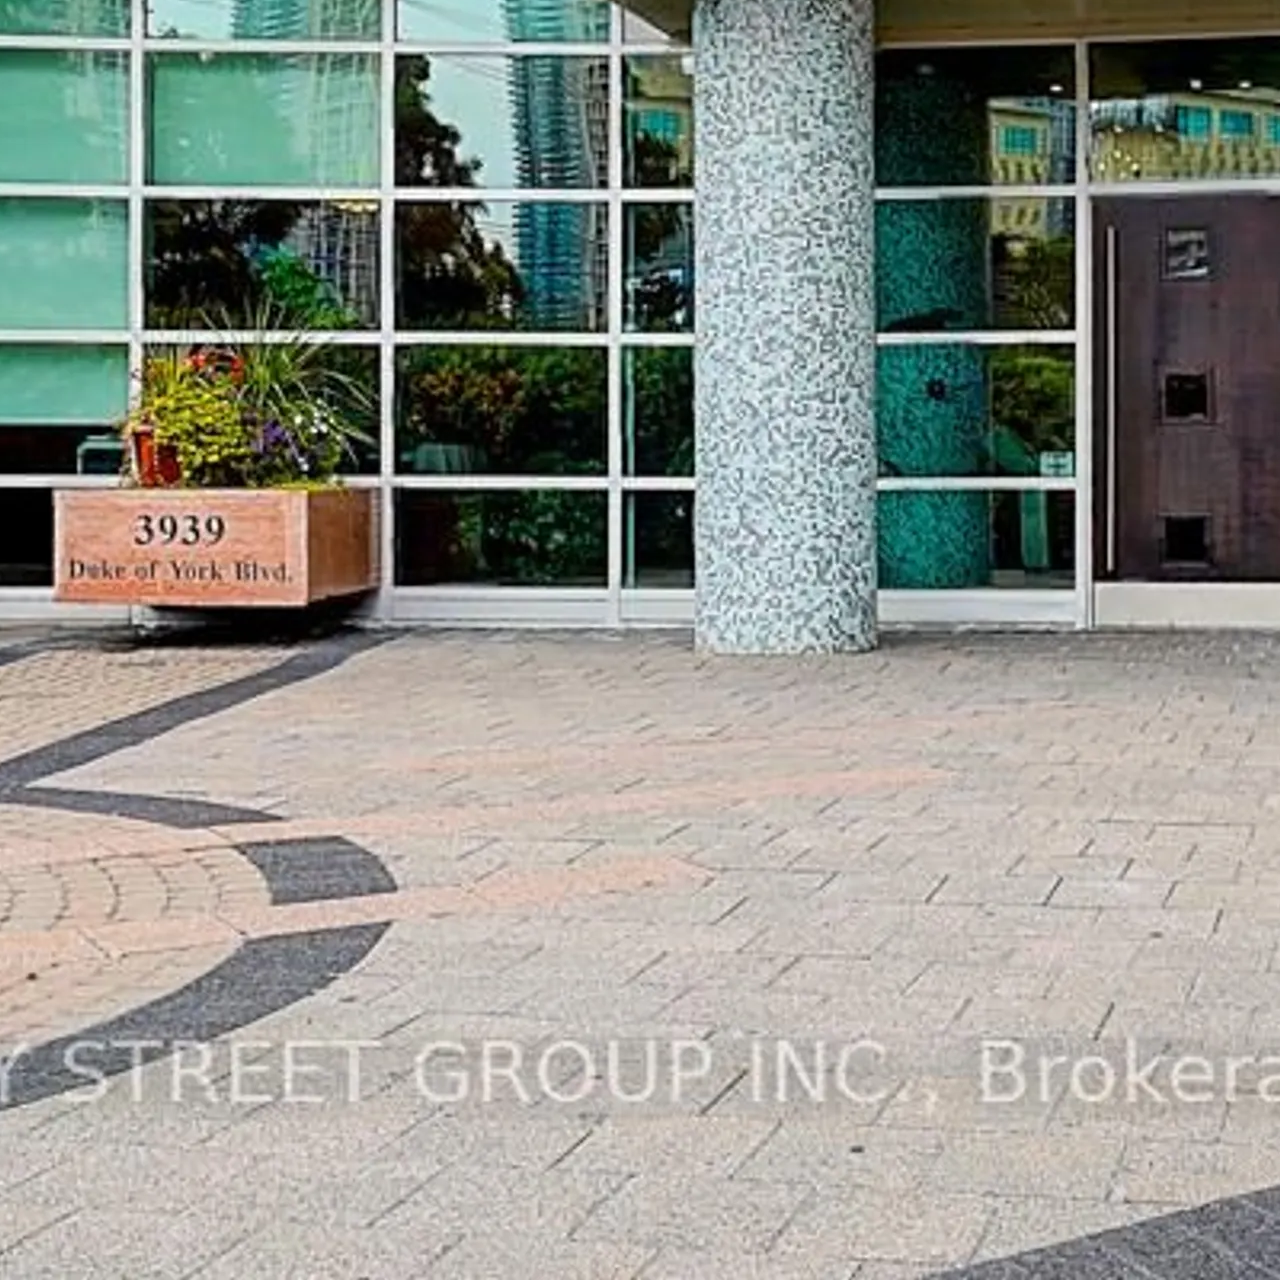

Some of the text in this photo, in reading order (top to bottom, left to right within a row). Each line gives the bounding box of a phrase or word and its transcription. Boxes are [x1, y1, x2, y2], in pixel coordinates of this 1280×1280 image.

[133, 514, 225, 547] 3939
[69, 559, 294, 583] Duke of York Blvd.
